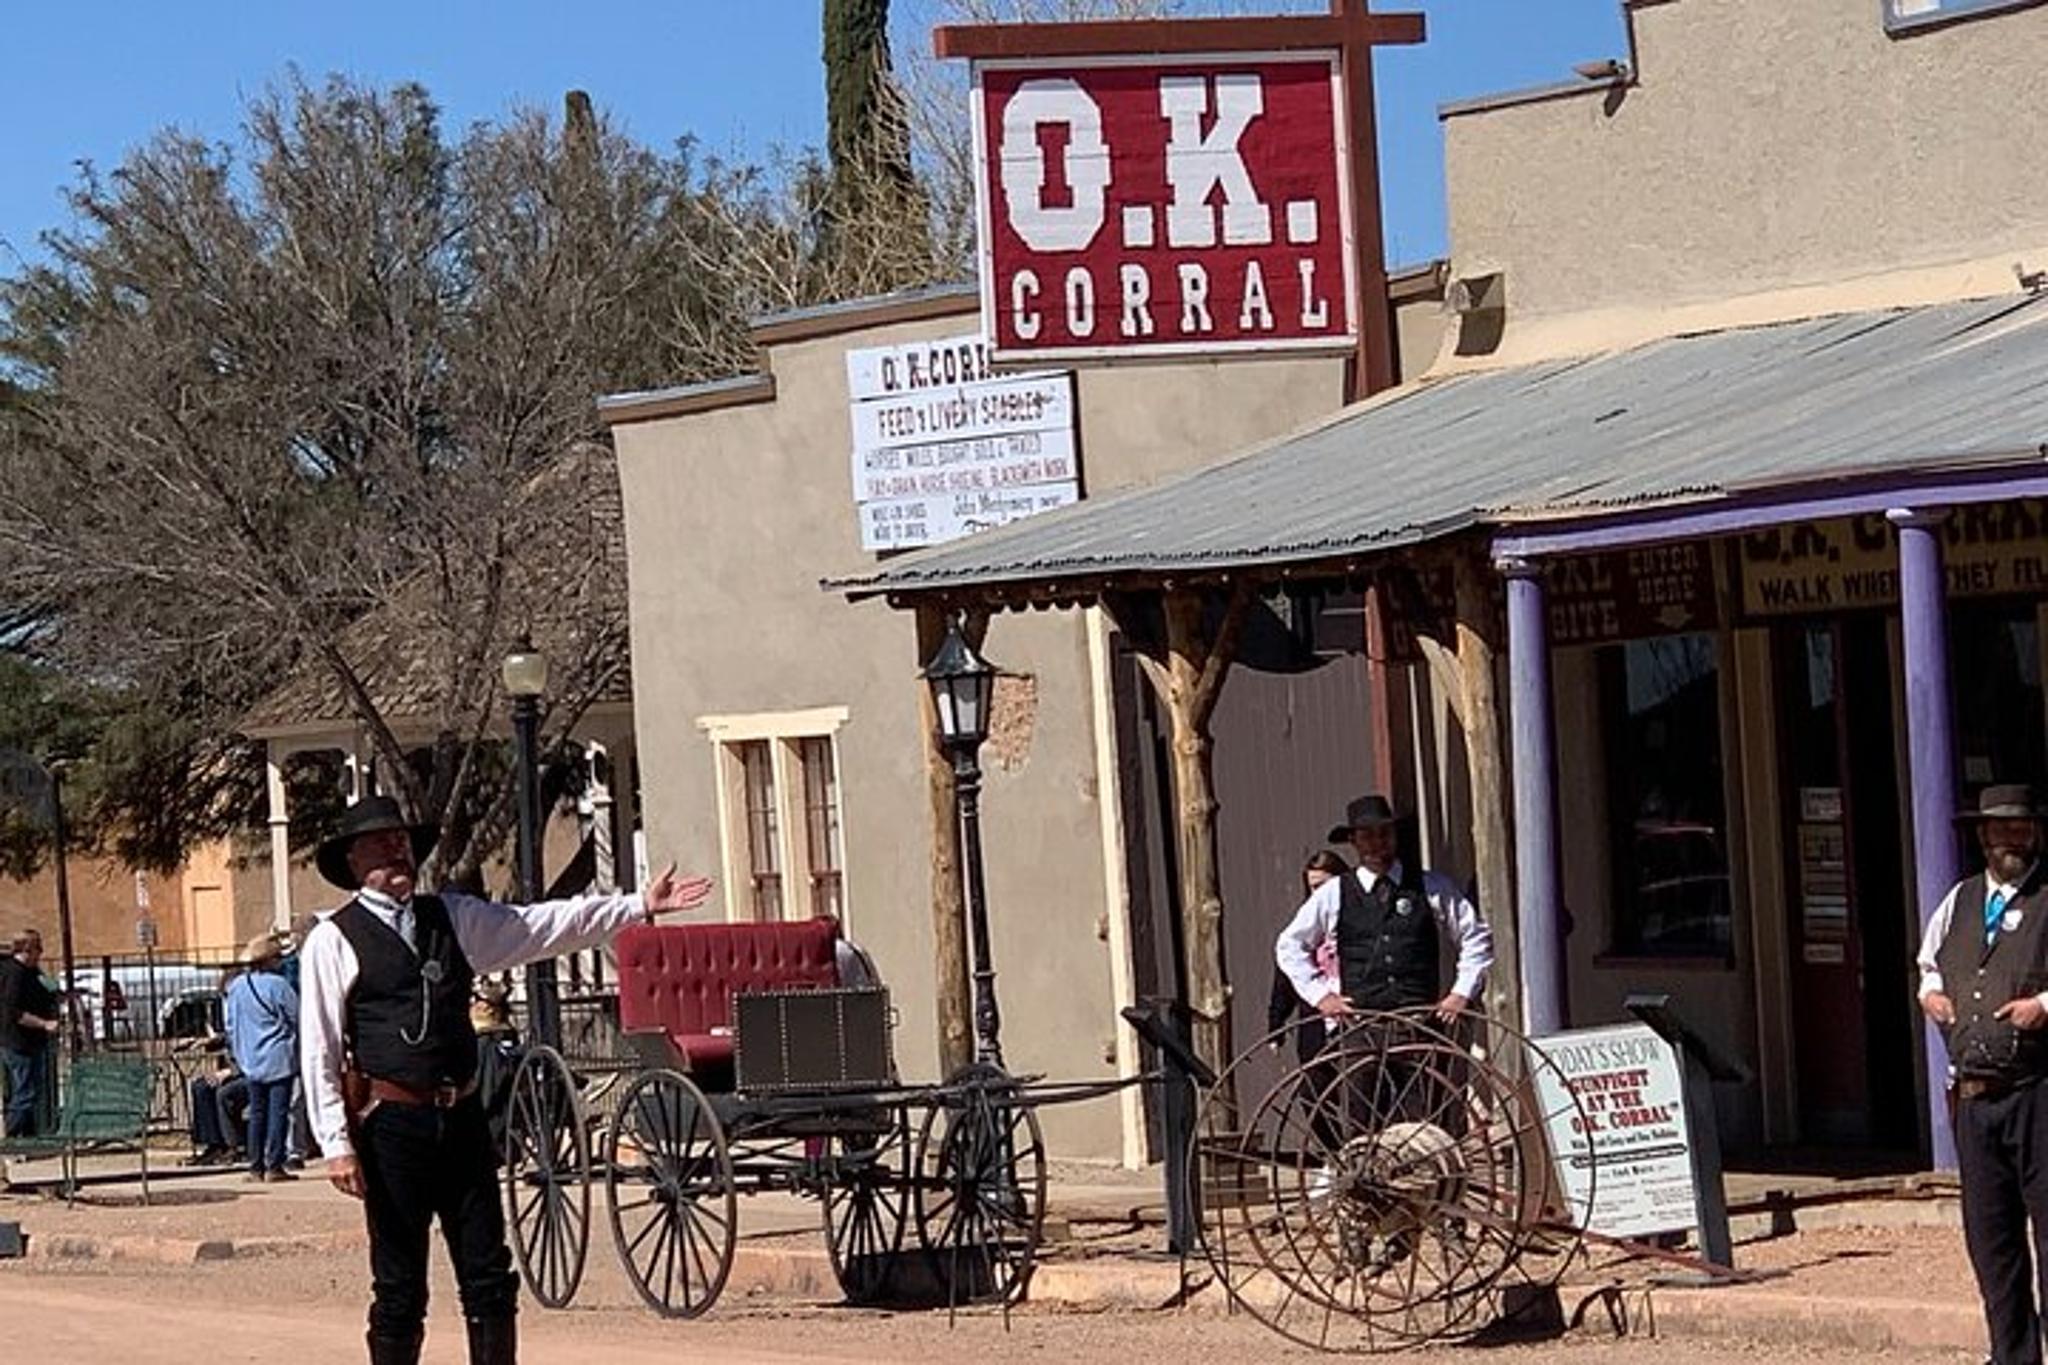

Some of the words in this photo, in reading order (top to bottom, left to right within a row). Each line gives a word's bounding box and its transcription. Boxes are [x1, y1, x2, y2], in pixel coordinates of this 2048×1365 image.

[1000, 74, 1318, 252] O.K.
[1012, 259, 1328, 339] CORRAL
[878, 406, 914, 438] FEED
[929, 398, 976, 431] LIVERY
[981, 391, 1044, 424] STABLES
[1627, 543, 1700, 577] ENTER
[1637, 573, 1696, 605] HERE
[1760, 573, 1831, 605] WALK
[1551, 598, 1620, 641] SITE
[1587, 1093, 1606, 1112] AT
[1610, 1089, 1643, 1110] THE
